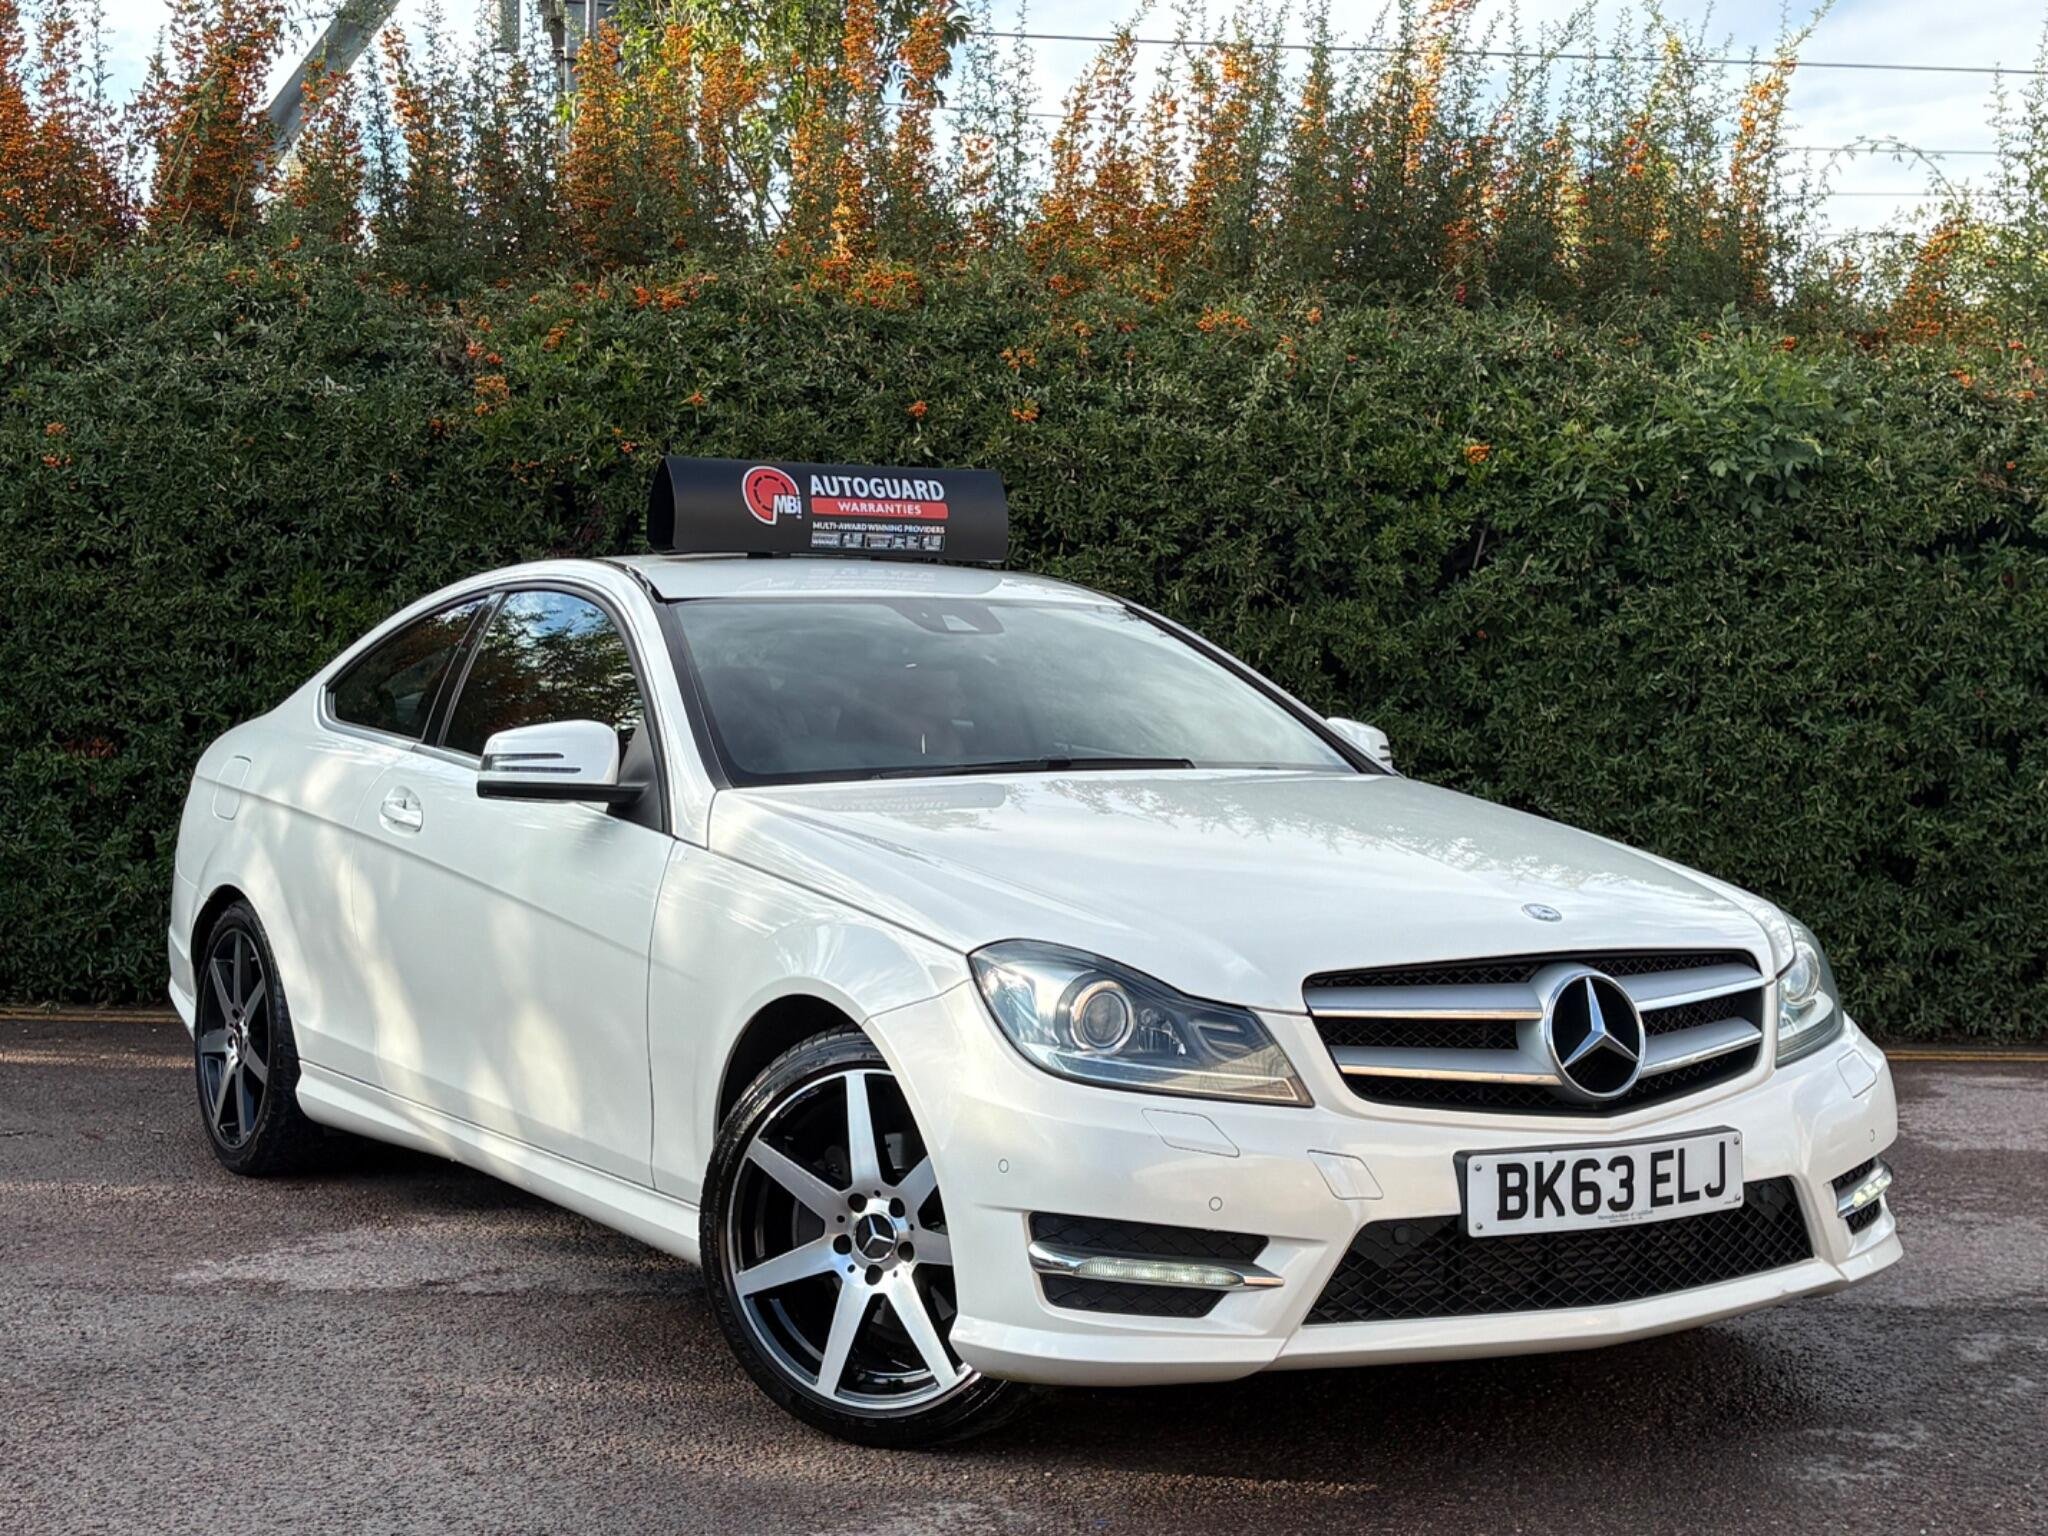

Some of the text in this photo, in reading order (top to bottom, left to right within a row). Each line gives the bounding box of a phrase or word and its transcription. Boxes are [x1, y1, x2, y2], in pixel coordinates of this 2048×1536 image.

[810, 474, 945, 501] AUTOGUARD
[774, 494, 802, 514] MBi
[837, 501, 922, 516] WARRANTIES
[812, 521, 945, 534] MULTI-AWARD WINNING PROVIDERS
[1497, 1141, 1726, 1221] BK63 ELJ
